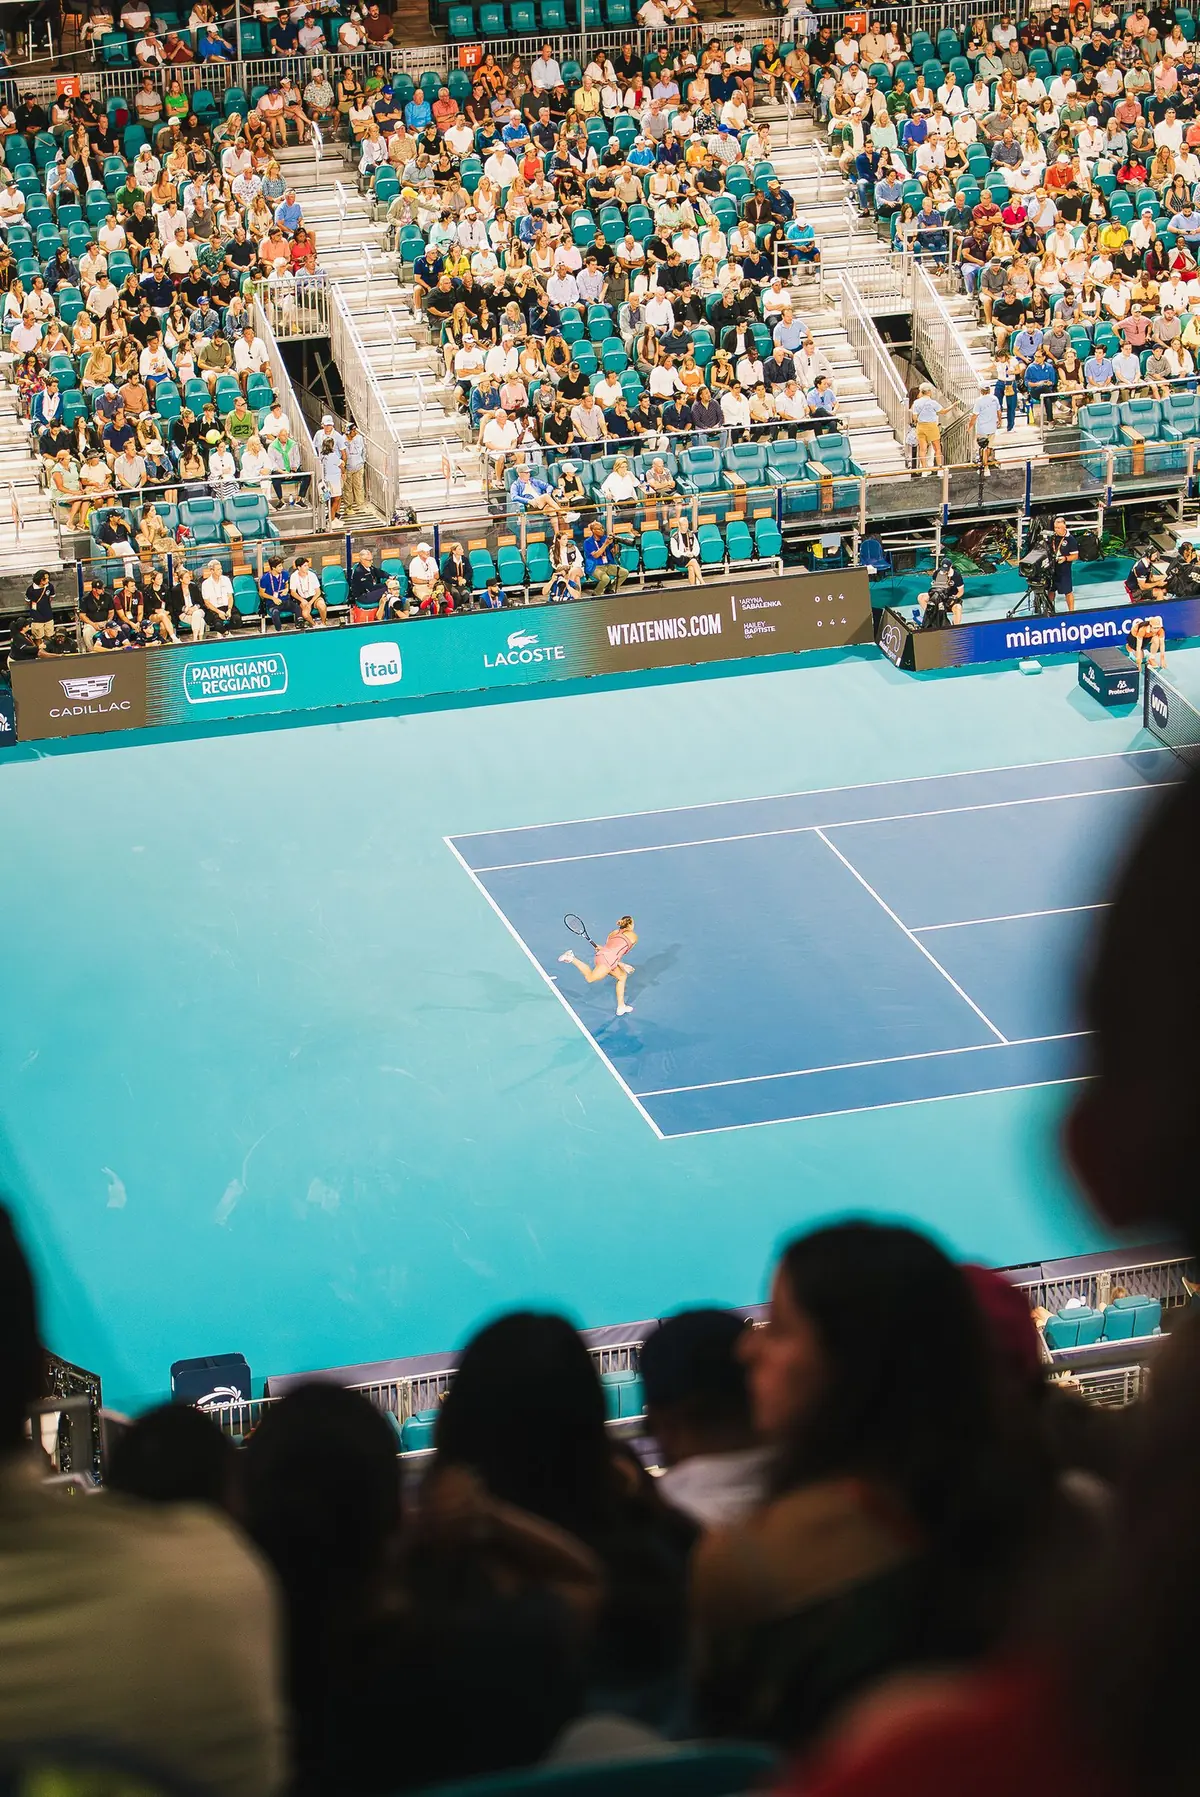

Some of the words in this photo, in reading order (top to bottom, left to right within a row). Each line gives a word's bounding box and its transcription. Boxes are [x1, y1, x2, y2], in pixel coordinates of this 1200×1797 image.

[852, 21, 859, 32] J
[466, 53, 476, 64] H
[63, 84, 73, 96] G
[741, 596, 764, 605] ARYNA
[827, 594, 834, 602] 6
[742, 600, 781, 610] SABALENKA
[606, 613, 722, 646] WTATENNIS.COM
[743, 620, 766, 630] HAILEY
[744, 625, 776, 635] BAPTISTE
[483, 645, 566, 668] LACOSTE
[191, 659, 278, 682] PARMIGIANO
[201, 674, 271, 695] REGGIANO
[1107, 687, 1135, 696] Protective
[49, 700, 131, 718] CADILLAC
